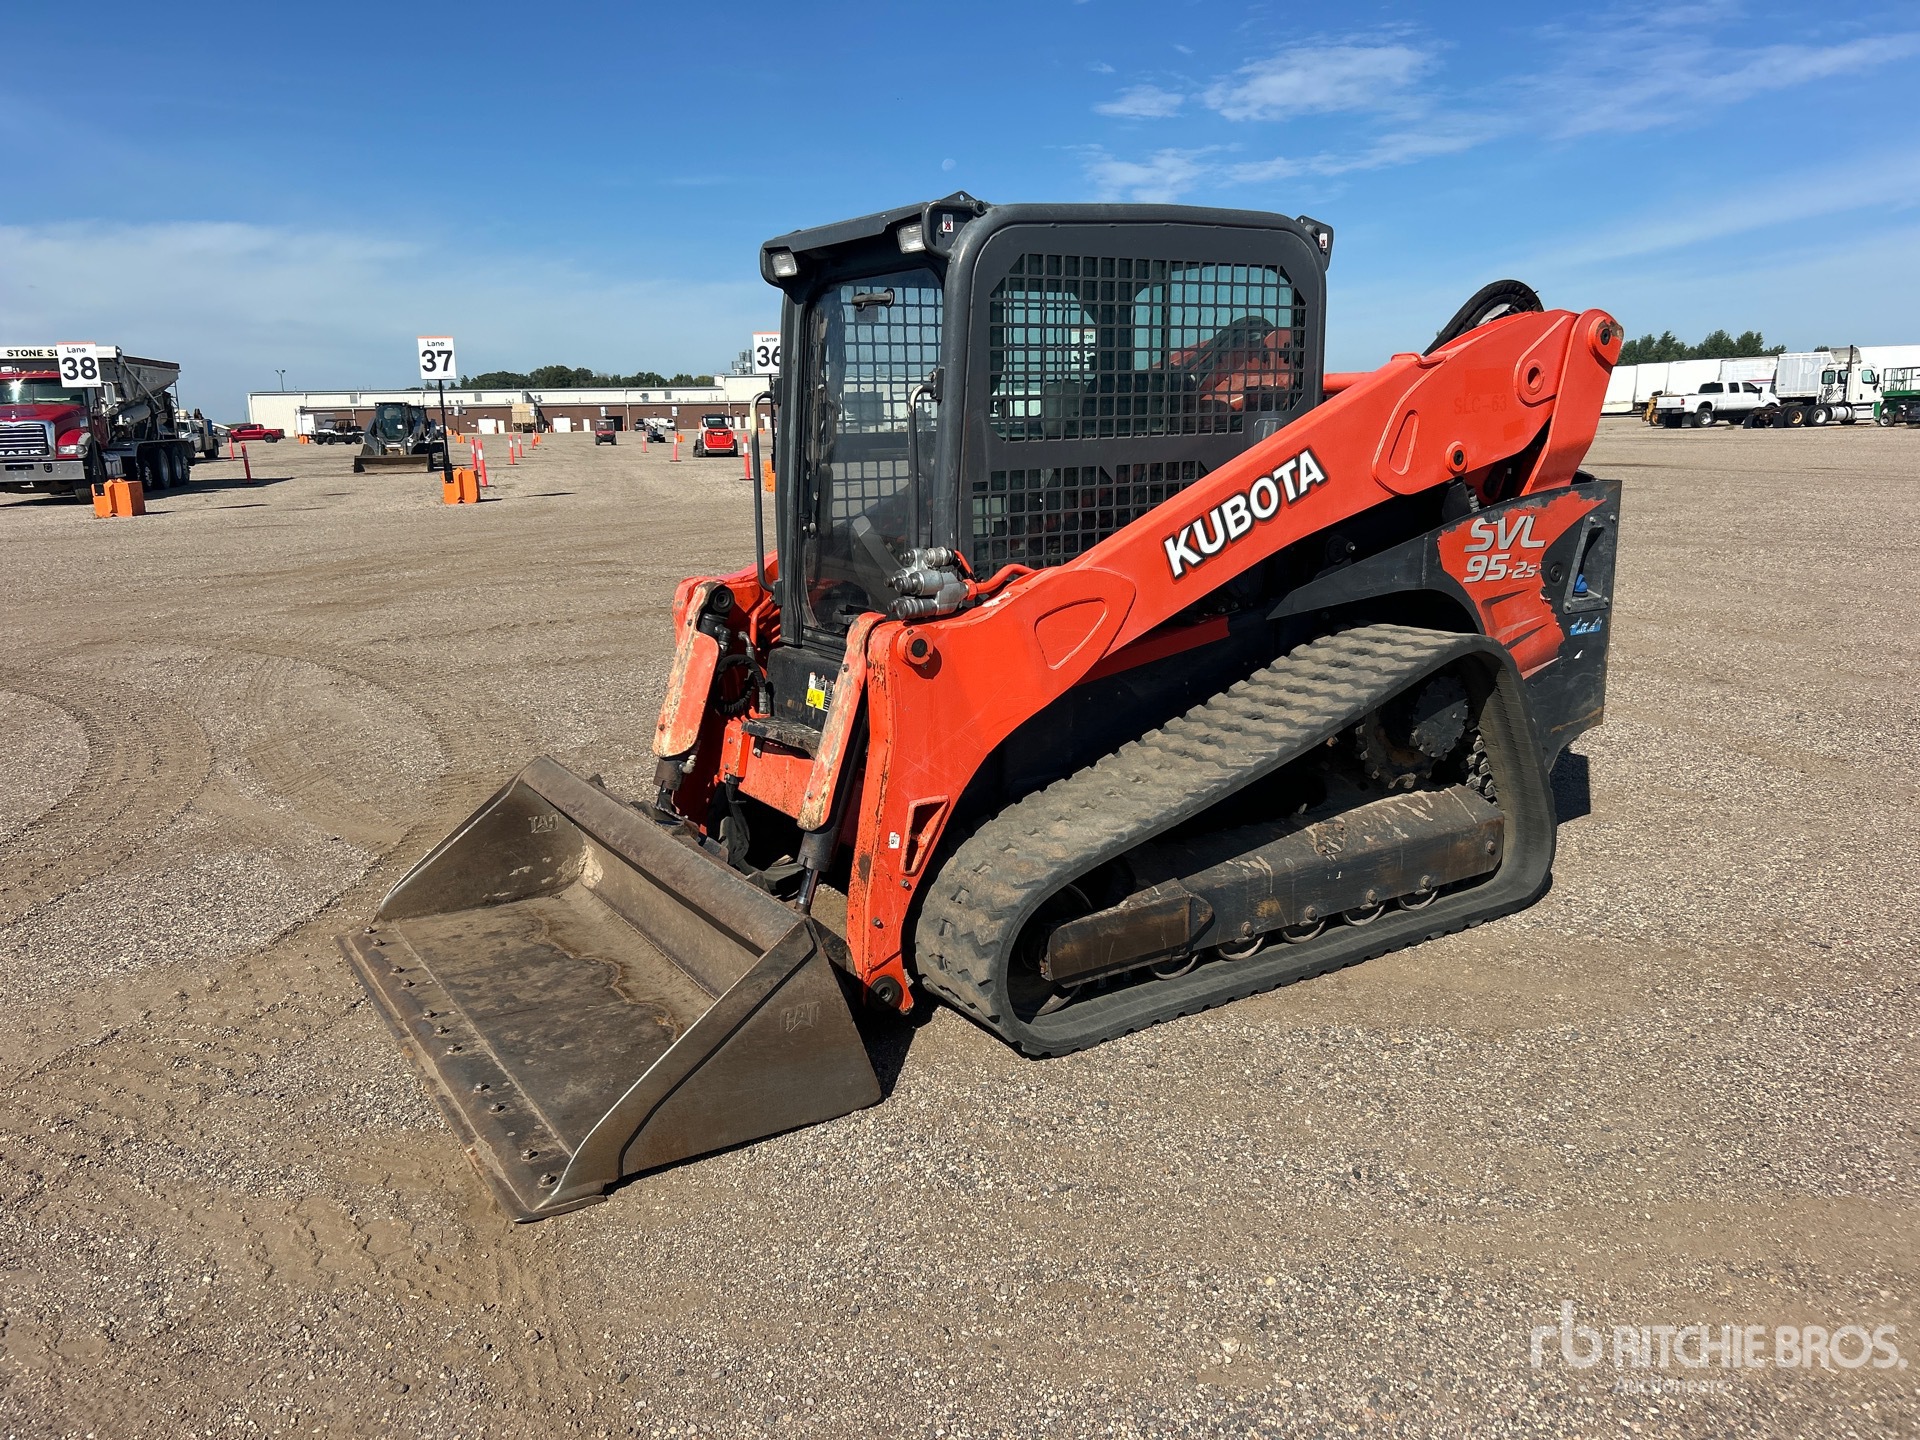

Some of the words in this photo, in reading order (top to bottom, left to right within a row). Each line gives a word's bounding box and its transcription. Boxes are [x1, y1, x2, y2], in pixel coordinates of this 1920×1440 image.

[421, 349, 453, 372] 37
[757, 346, 780, 367] 36
[62, 357, 97, 380] 38
[1162, 448, 1327, 580] KUBOTA
[1463, 515, 1547, 553] SVL
